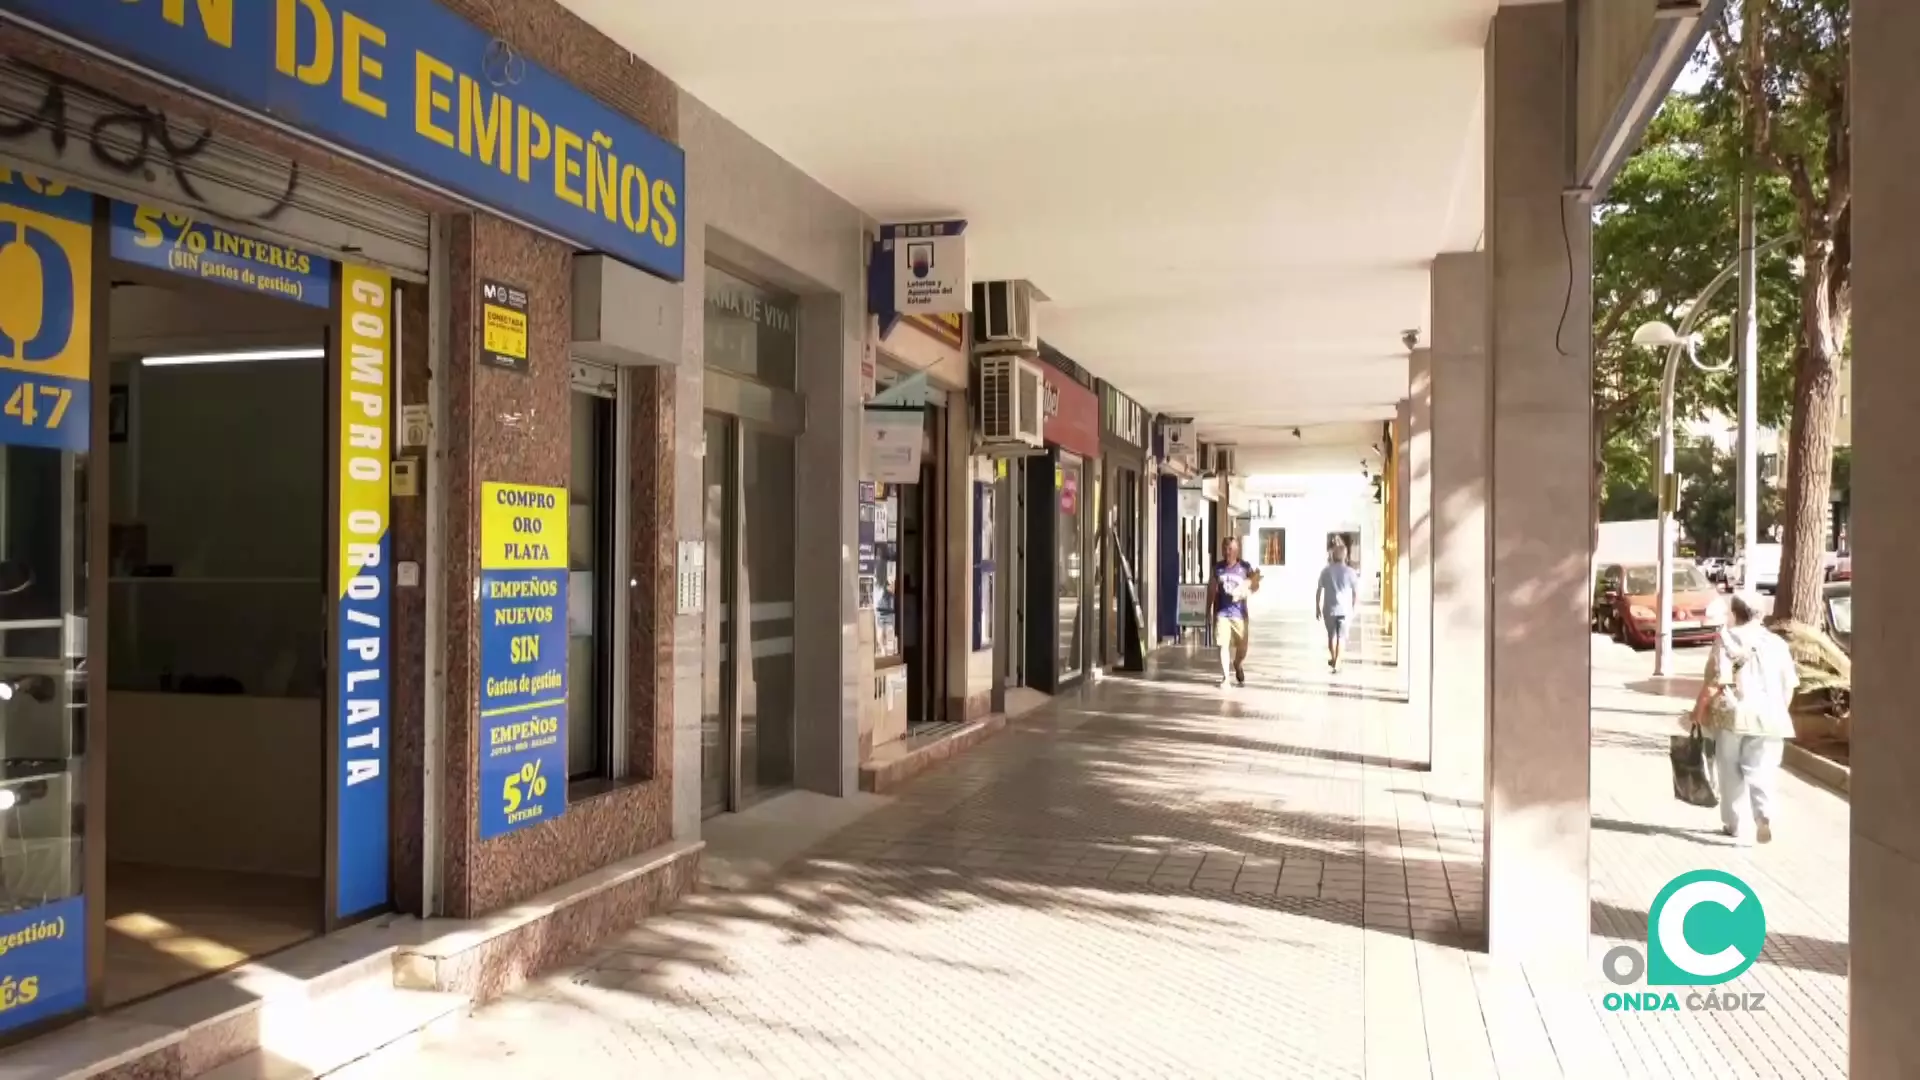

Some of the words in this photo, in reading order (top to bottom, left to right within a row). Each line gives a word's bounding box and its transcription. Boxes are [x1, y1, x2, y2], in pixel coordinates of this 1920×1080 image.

[276, 0, 388, 118] DE
[415, 50, 677, 248] EMPEÑOS
[133, 204, 207, 254] 5%
[213, 230, 310, 275] INTERÉS
[201, 260, 239, 281] gastos
[242, 268, 255, 285] de
[257, 275, 303, 300] gestión)
[743, 299, 761, 322] DE
[348, 278, 385, 482] COMPRO
[4, 381, 72, 429] 47
[497, 489, 556, 510] COMPRO
[513, 516, 542, 533] ORO
[504, 543, 549, 560] PLATA
[490, 576, 558, 598] EMPEÑOS
[495, 606, 553, 626] NUEVOS
[346, 510, 382, 787] ORO/PLATA
[510, 635, 540, 665] SIN
[486, 676, 518, 697] Gastos
[519, 673, 531, 693] de
[531, 669, 562, 695] gestión
[490, 715, 558, 745] EMPEÑOS
[503, 758, 547, 815] 5%
[508, 803, 543, 824] INTERÉS
